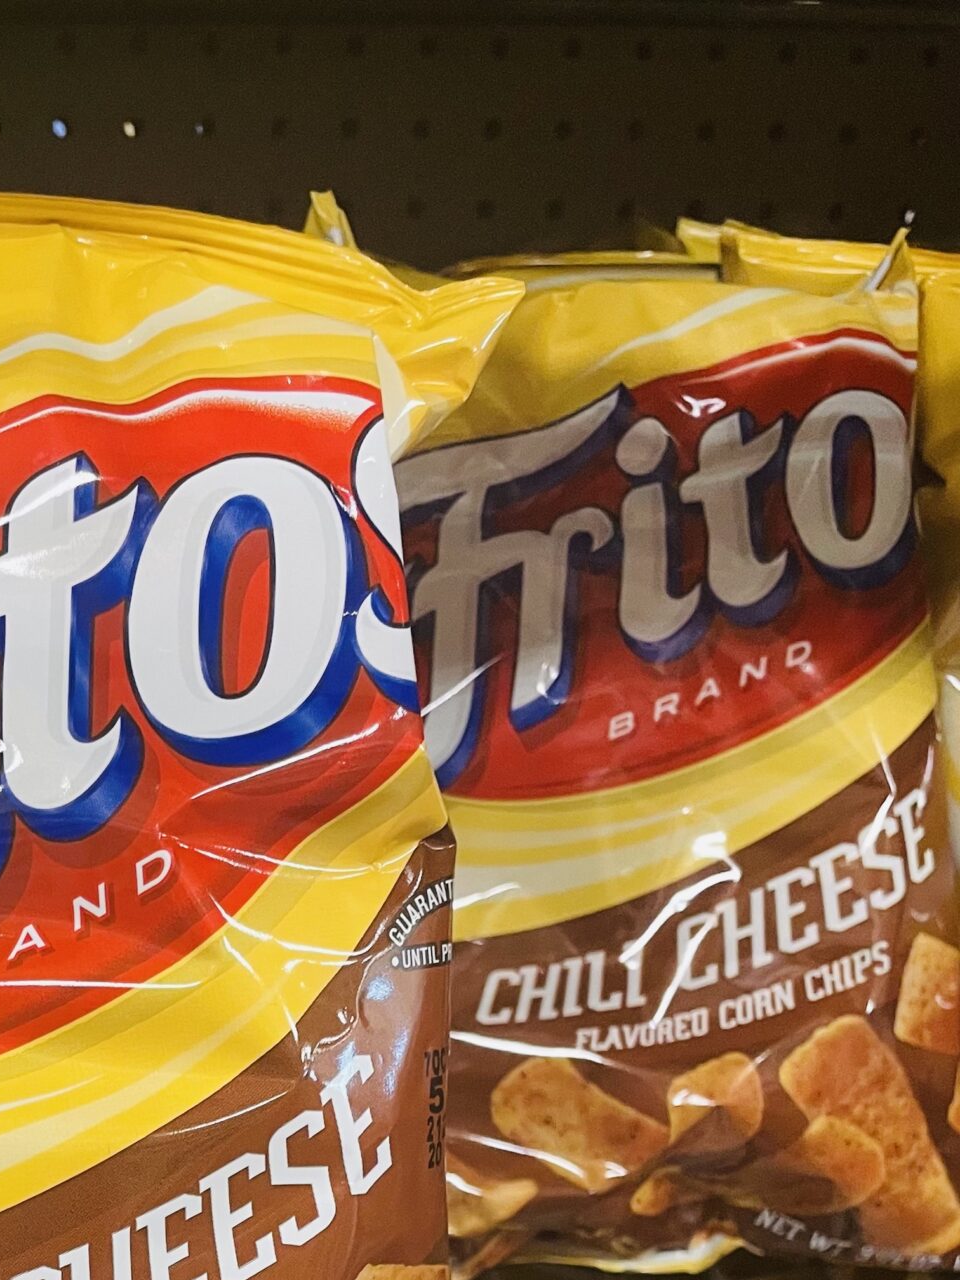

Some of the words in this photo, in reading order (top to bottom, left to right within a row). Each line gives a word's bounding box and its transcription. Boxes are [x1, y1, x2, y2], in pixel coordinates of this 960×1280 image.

[608, 640, 813, 741] BRAND
[401, 945, 439, 968] UNTIL
[475, 940, 647, 1026] CHILI
[676, 788, 936, 991] CHEESE
[575, 1007, 709, 1054] FLAVORED
[719, 978, 796, 1032] CORN
[804, 940, 893, 1001] CHIPS
[753, 1207, 807, 1241] NET
